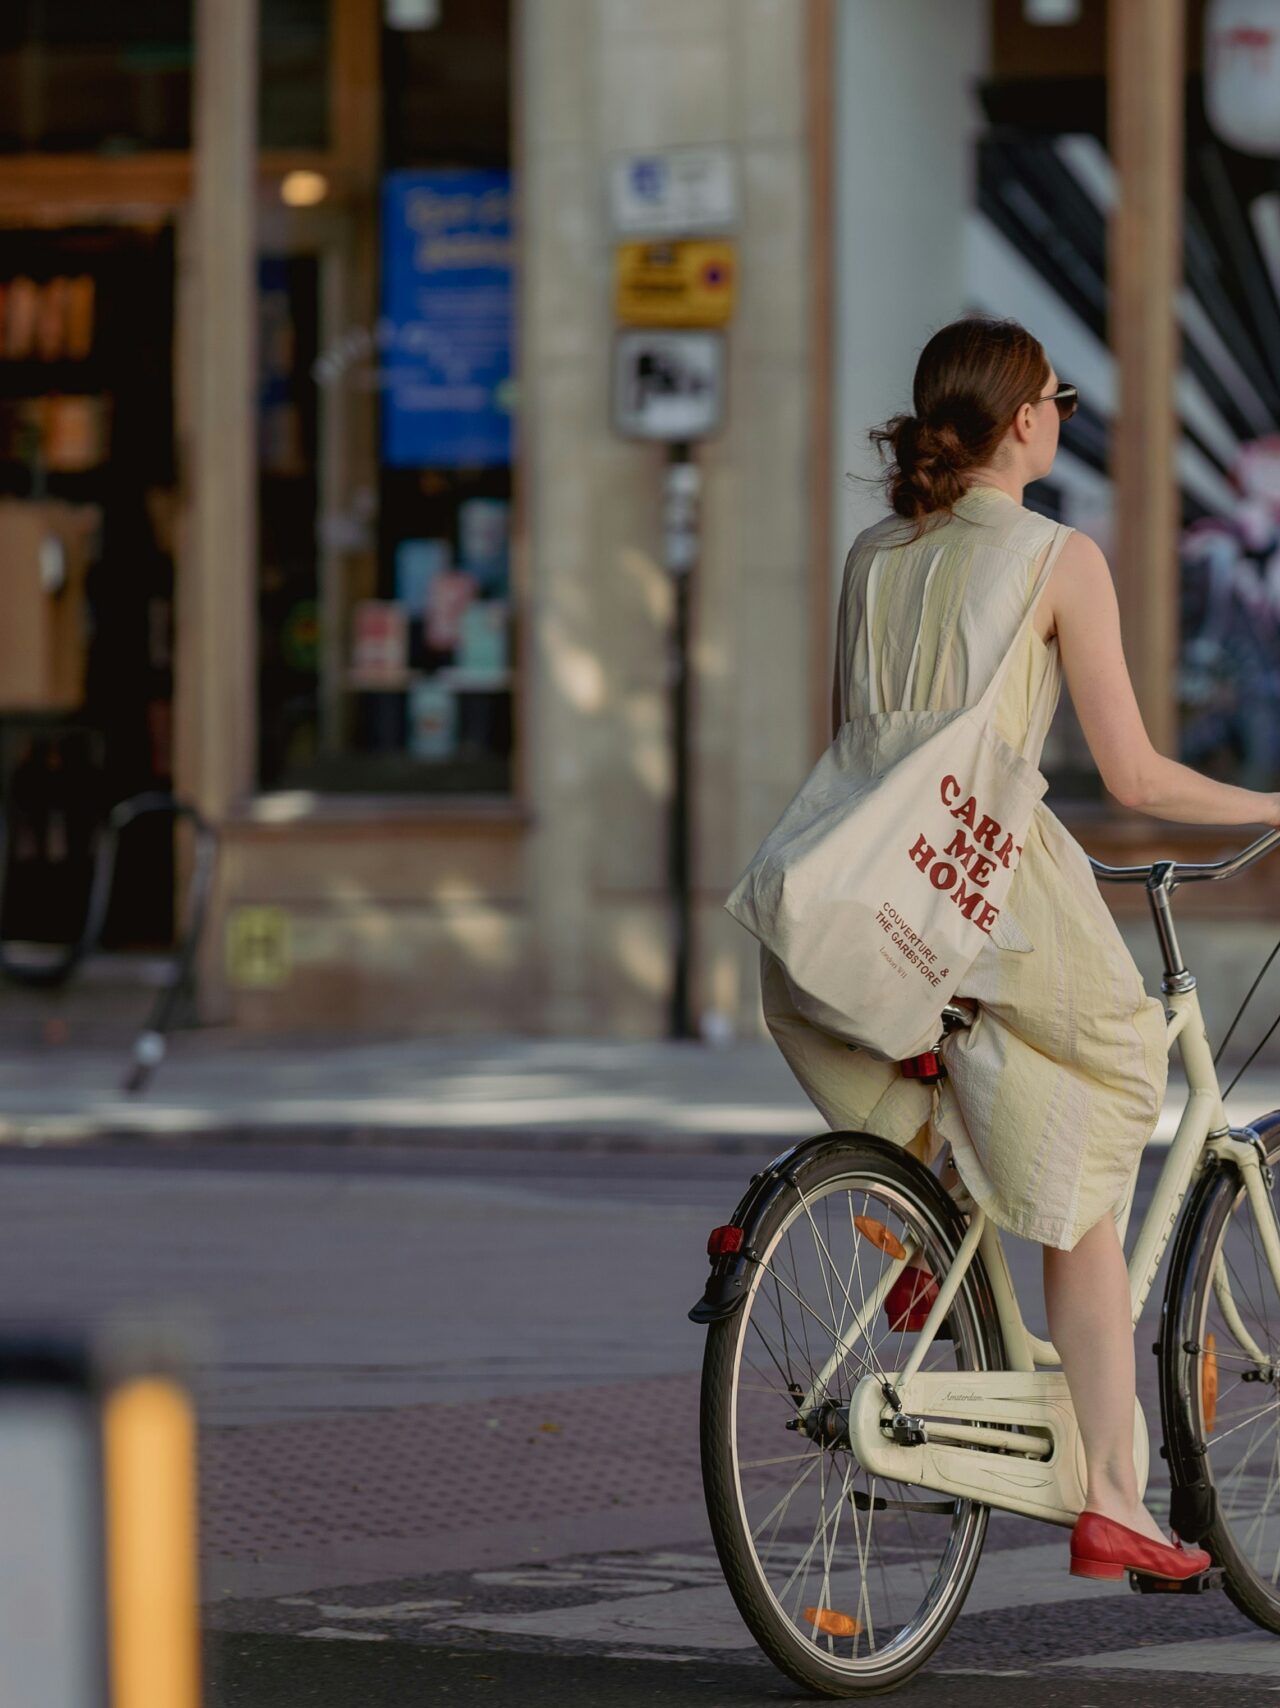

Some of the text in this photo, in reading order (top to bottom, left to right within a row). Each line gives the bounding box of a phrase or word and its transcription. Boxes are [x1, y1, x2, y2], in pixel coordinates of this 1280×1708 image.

[940, 774, 1023, 869] CARR
[943, 829, 997, 889] ME
[908, 833, 1000, 935] HOME
[875, 910, 942, 988] THE GARBSTORE
[883, 902, 950, 978] COUVERTURE &
